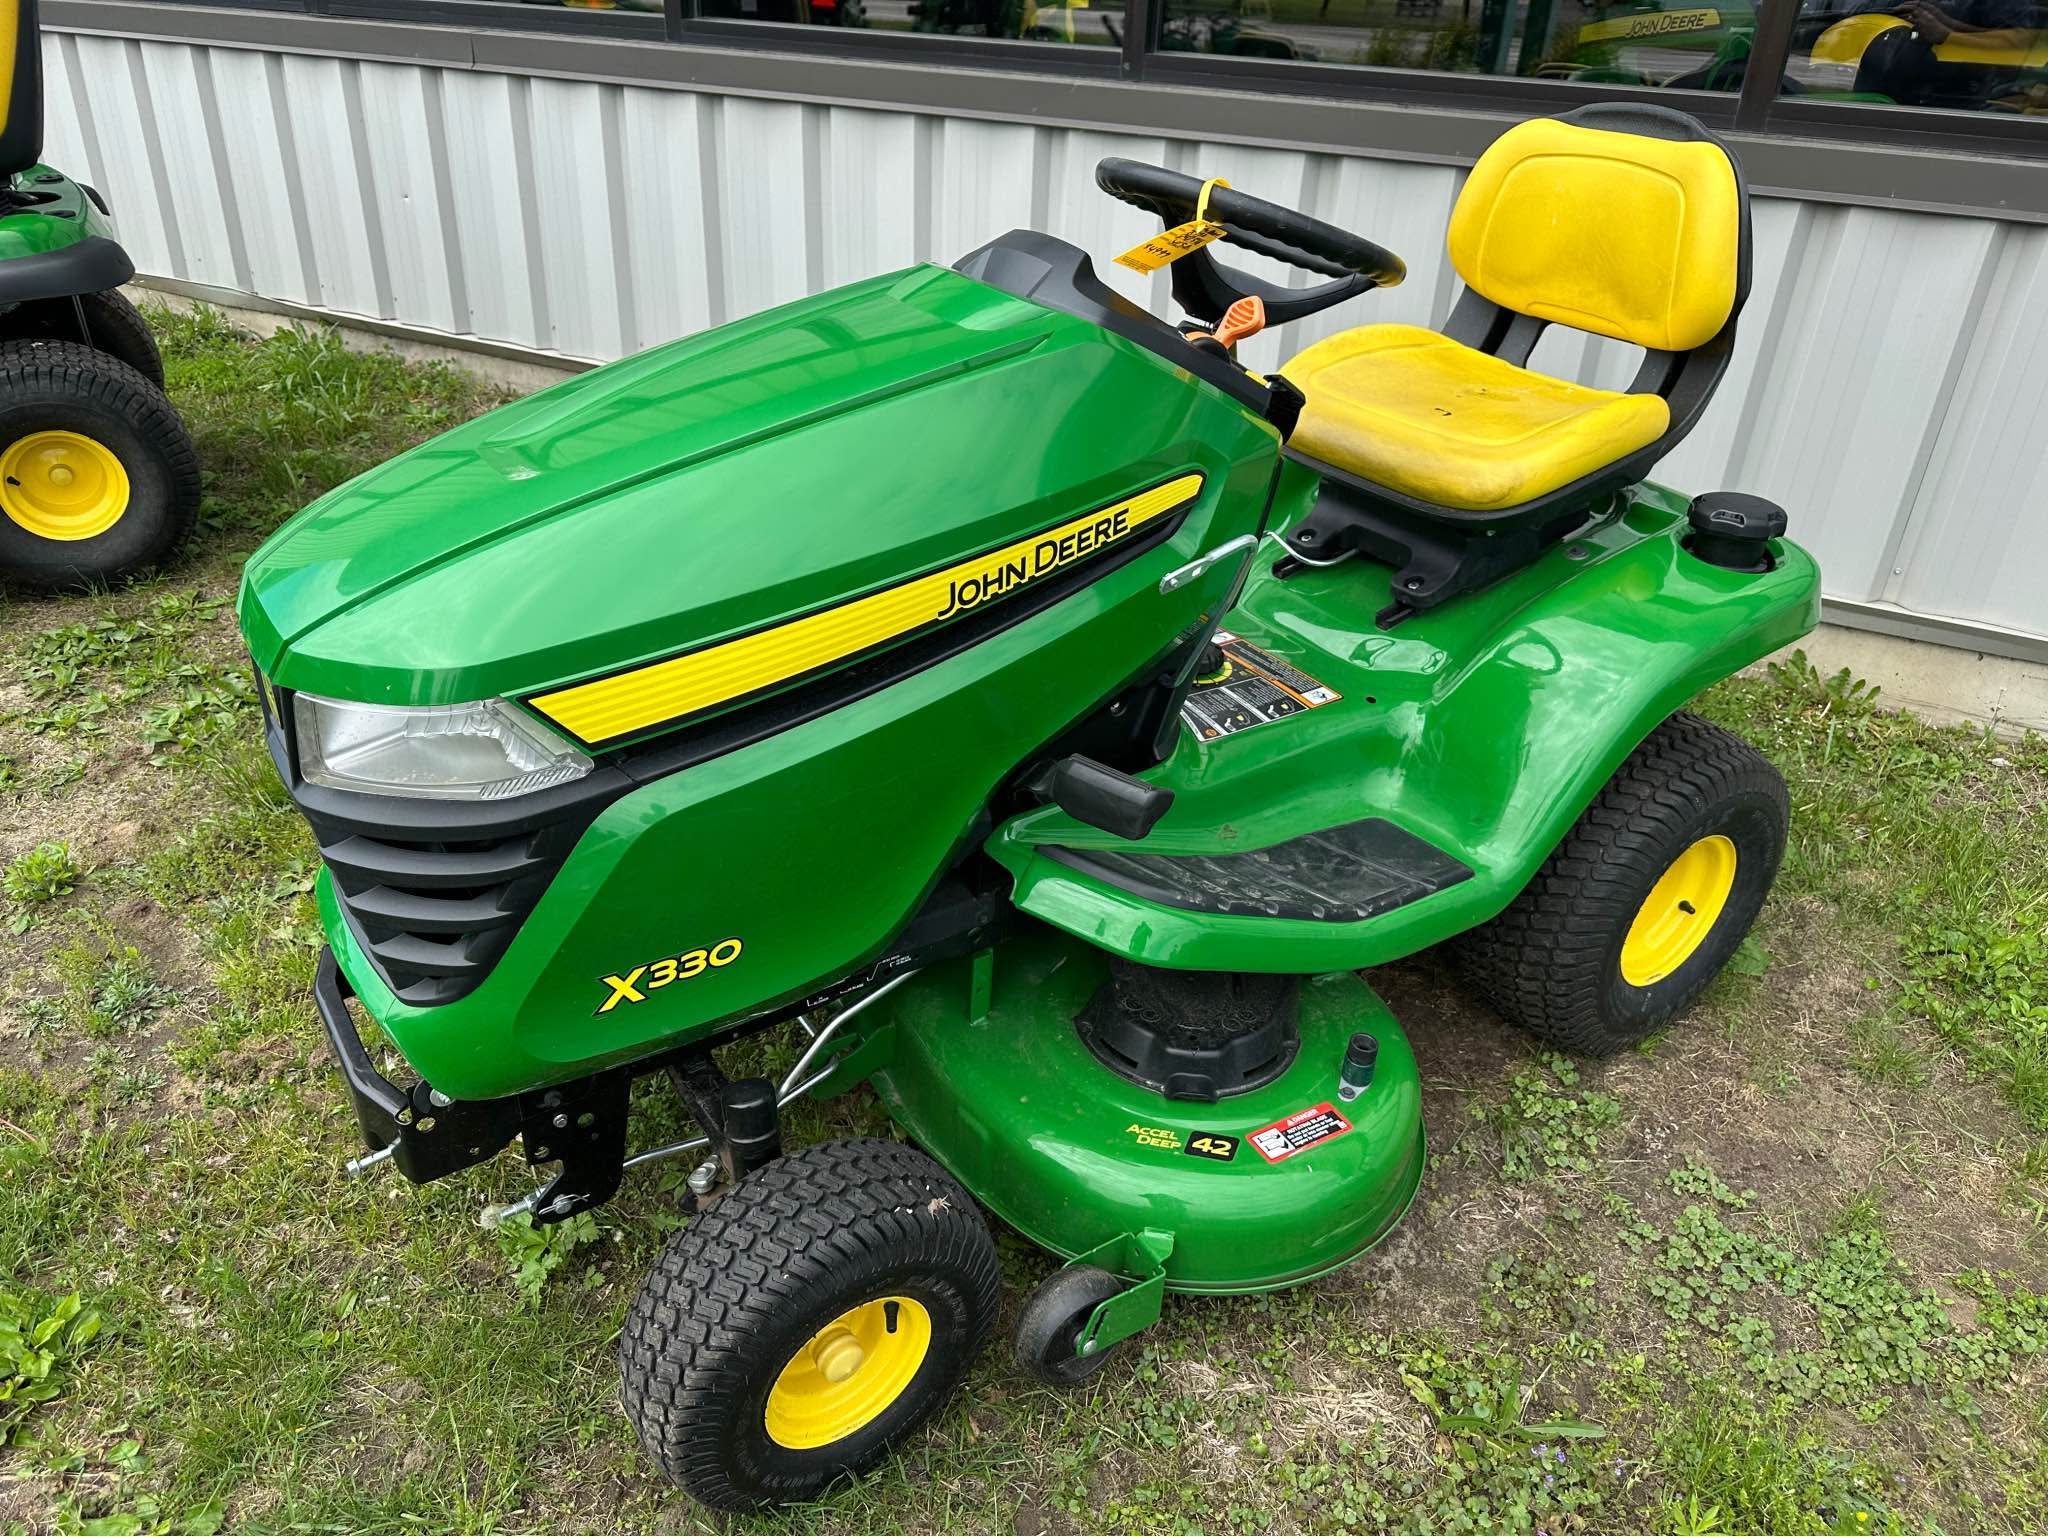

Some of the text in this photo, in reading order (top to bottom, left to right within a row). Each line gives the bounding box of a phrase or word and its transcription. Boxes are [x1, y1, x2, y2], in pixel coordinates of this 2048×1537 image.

[1625, 13, 1707, 37] JOHN DEERE
[937, 508, 1130, 618] JOHN DEERE
[595, 937, 743, 1014] X330
[1126, 1123, 1178, 1140] ACCEL
[1136, 1134, 1181, 1150] DEEP
[1192, 1137, 1232, 1156] 42
